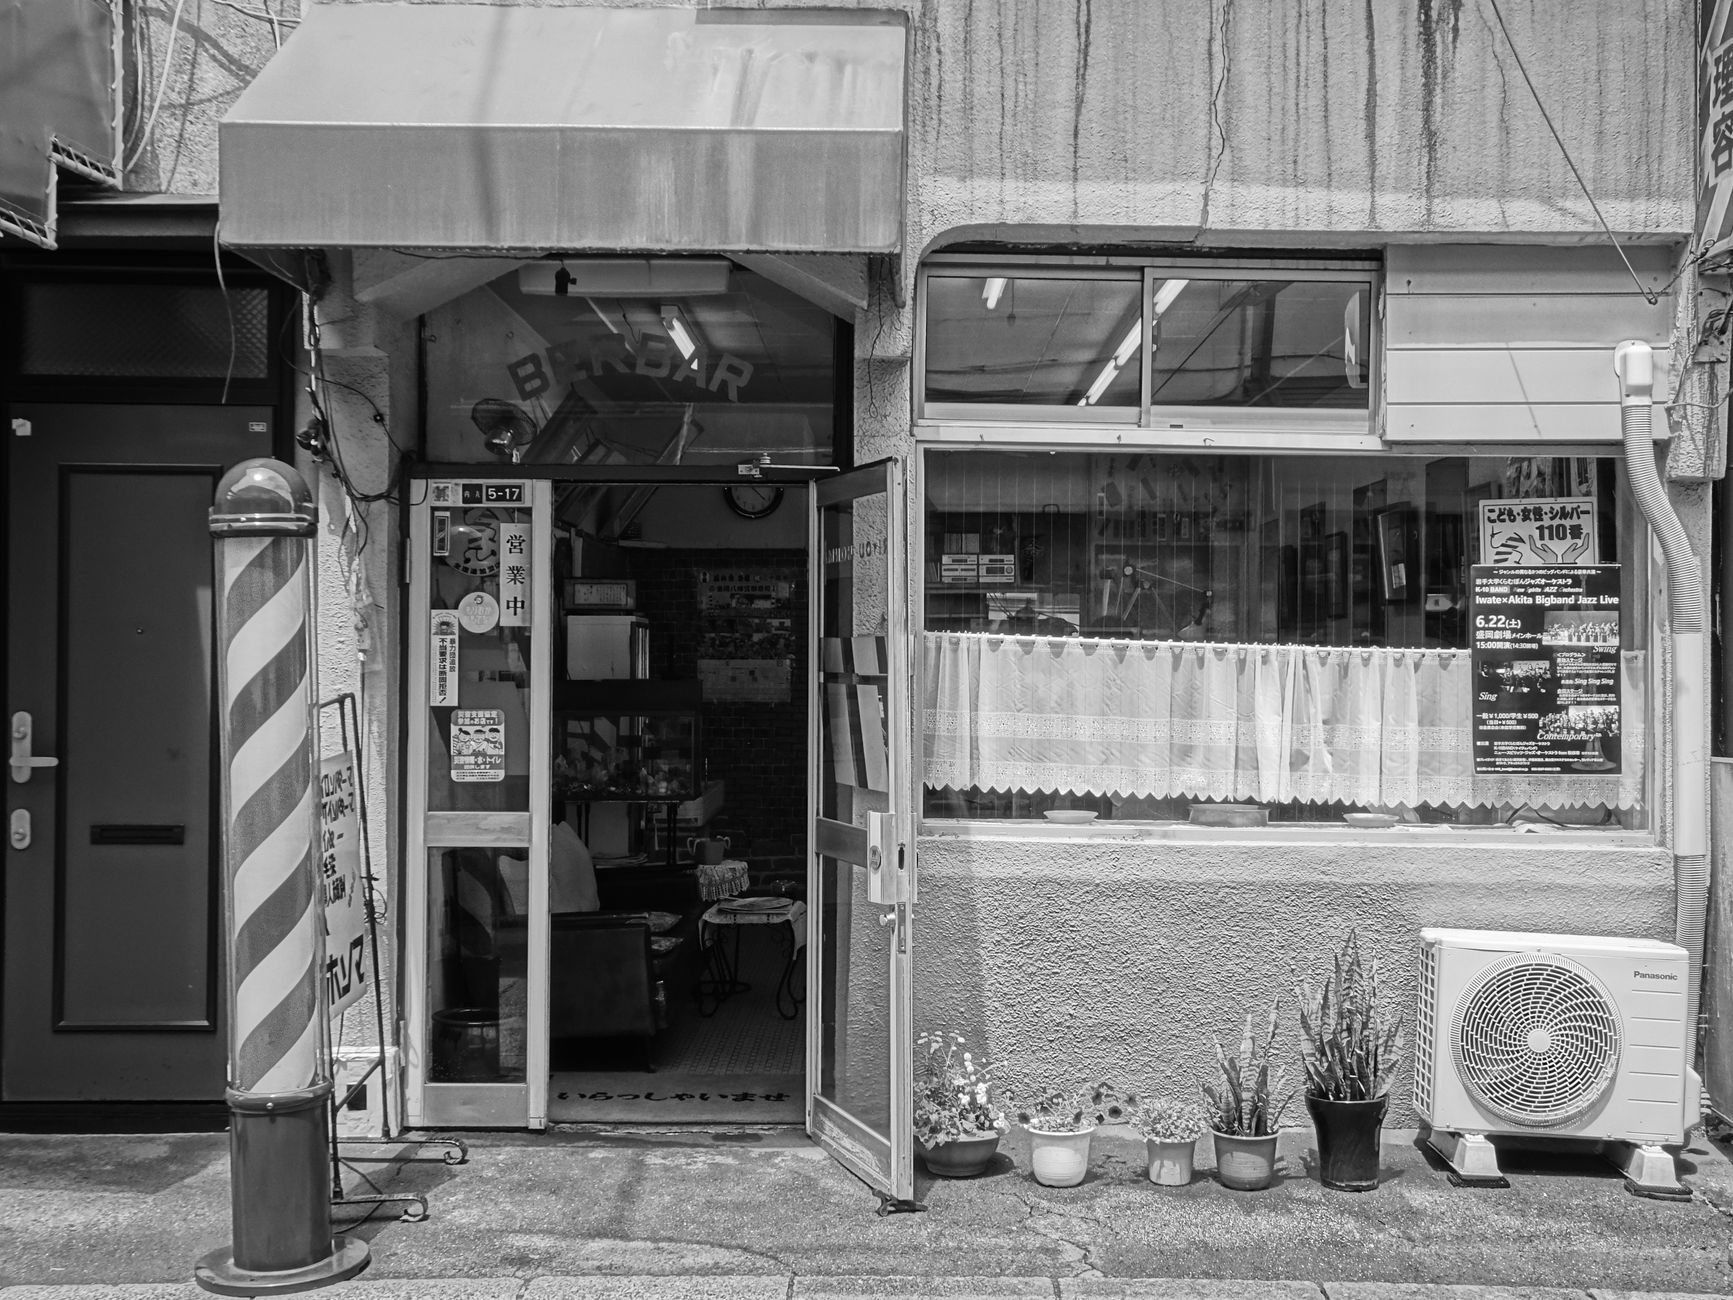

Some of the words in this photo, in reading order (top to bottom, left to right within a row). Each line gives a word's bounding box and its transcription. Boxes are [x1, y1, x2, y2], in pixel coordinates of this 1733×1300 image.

[1702, 52, 1733, 178] 理容
[488, 488, 520, 500] 5-17
[1487, 505, 1591, 523] こども・女性・シルバー
[1536, 524, 1584, 541] 110番
[506, 534, 526, 616] 営業中
[1535, 594, 1575, 606] Bigband
[1577, 595, 1597, 604] Jazz
[1600, 595, 1619, 604] Live
[1475, 615, 1521, 629] 6.22(土)
[1593, 645, 1618, 654] Swing
[1479, 691, 1498, 701] Sing
[1537, 732, 1595, 742] Contemporary
[1633, 970, 1678, 981] Panasonic
[557, 1090, 791, 1102] いらっしゃいませ
